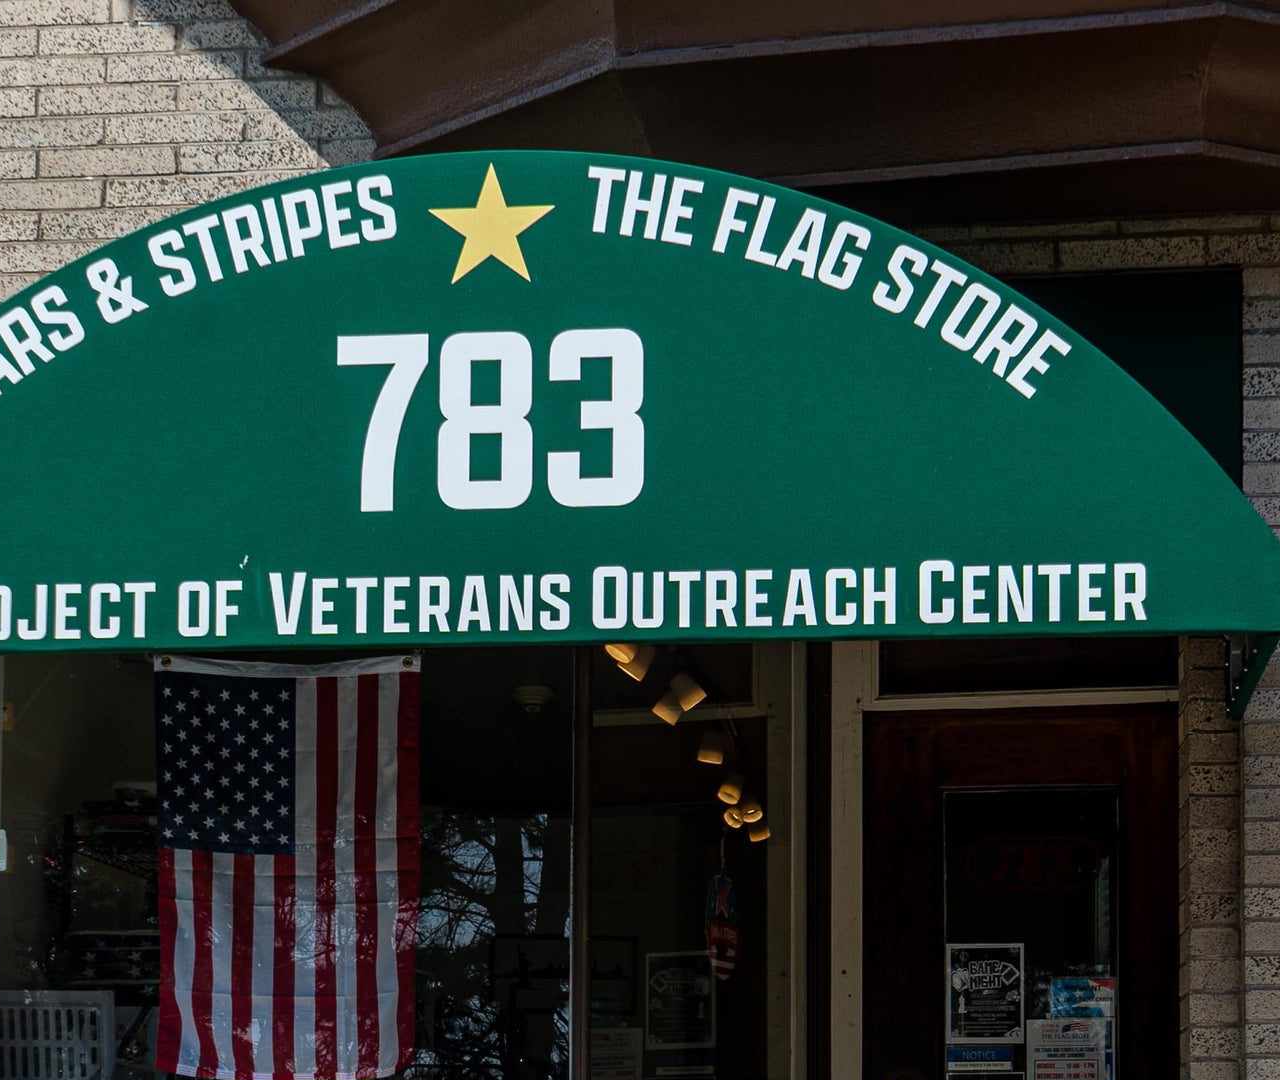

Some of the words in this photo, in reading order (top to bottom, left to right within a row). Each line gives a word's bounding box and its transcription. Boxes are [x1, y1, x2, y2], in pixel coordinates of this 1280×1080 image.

[86, 258, 149, 324] &
[147, 175, 397, 297] STRIPES
[588, 166, 705, 246] THE
[712, 187, 871, 290] FLAG
[872, 245, 1072, 399] STORE
[336, 328, 645, 513] 783
[969, 960, 1000, 976] GAME
[969, 974, 1002, 991] NIGHT
[962, 1051, 997, 1060] NOTICE
